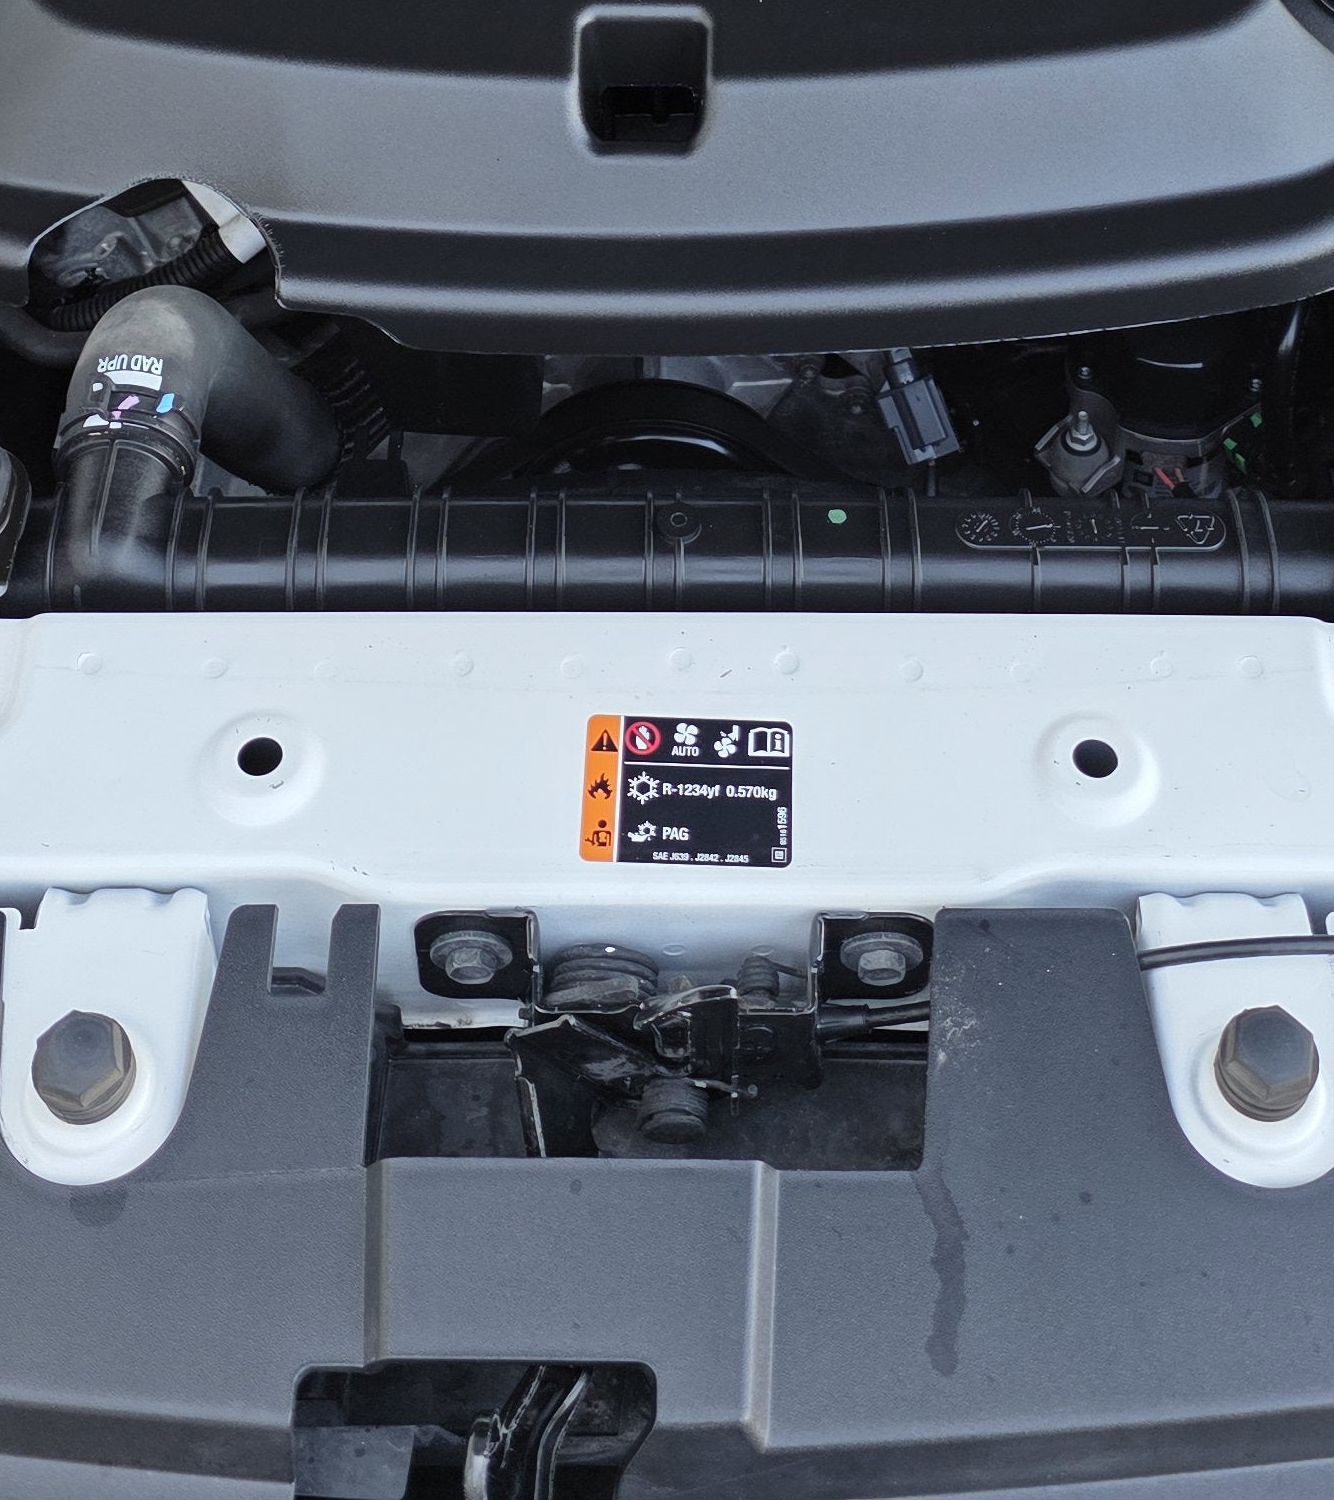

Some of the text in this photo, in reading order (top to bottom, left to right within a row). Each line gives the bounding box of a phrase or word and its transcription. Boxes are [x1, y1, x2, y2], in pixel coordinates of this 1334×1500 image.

[97, 353, 163, 375] RAD UPR
[671, 746, 699, 757] AUTO
[662, 783, 777, 800] R-1234yf 0.570kg
[662, 827, 690, 841] PAG
[652, 851, 668, 860] SAE
[695, 853, 719, 862] J2842
[724, 853, 749, 863] J2845
